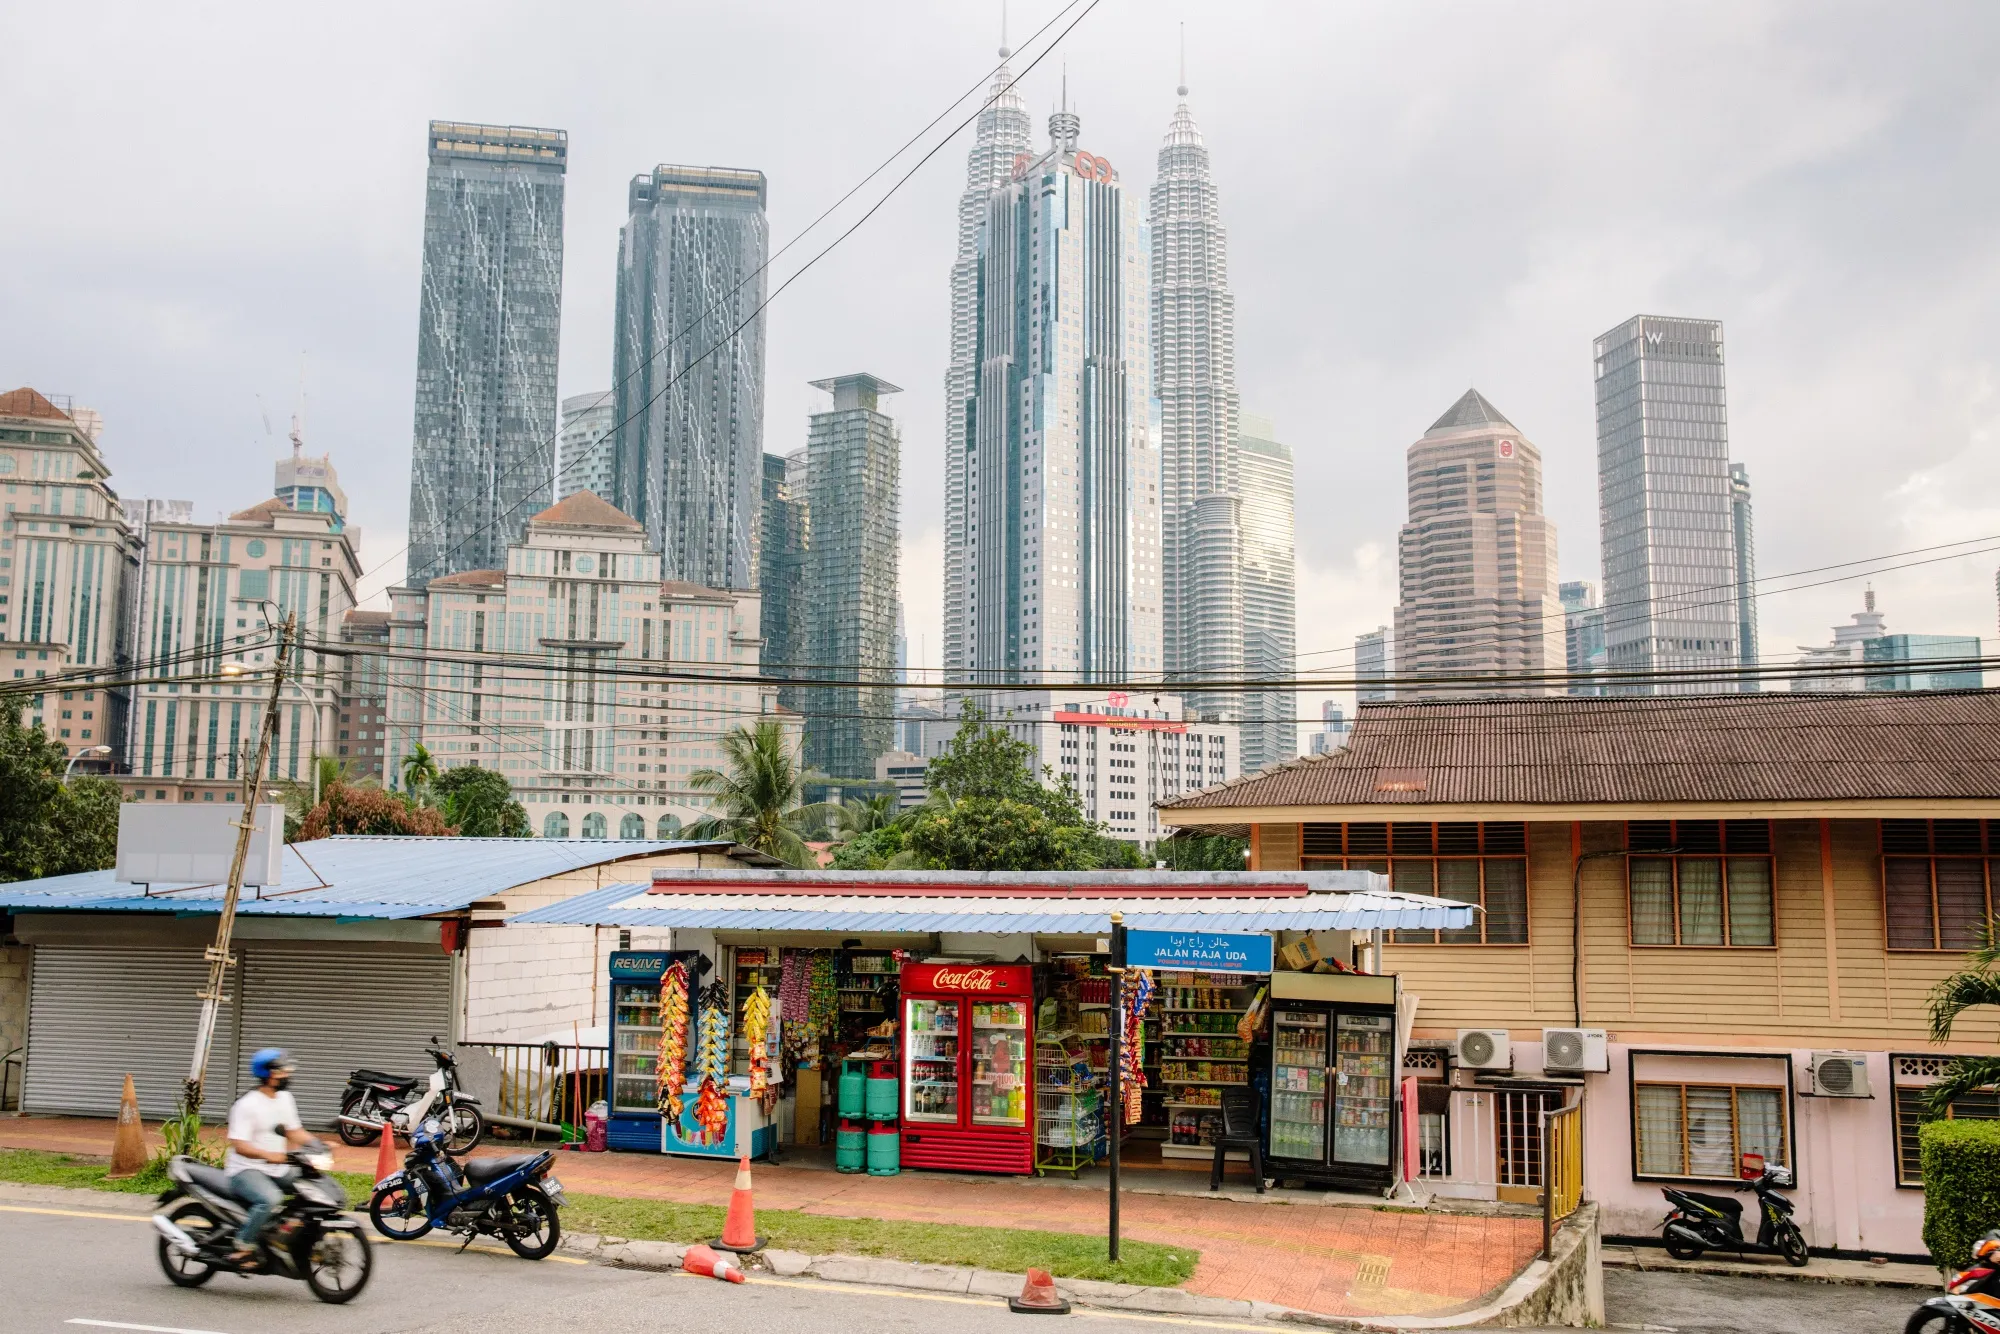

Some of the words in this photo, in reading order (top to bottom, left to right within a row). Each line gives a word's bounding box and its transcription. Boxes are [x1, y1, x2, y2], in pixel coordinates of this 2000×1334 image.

[1646, 331, 1663, 345] W
[1154, 948, 1189, 958] JALAN
[1192, 949, 1221, 959] RAJA
[1225, 951, 1247, 961] UDA
[614, 958, 662, 969] REVIVE
